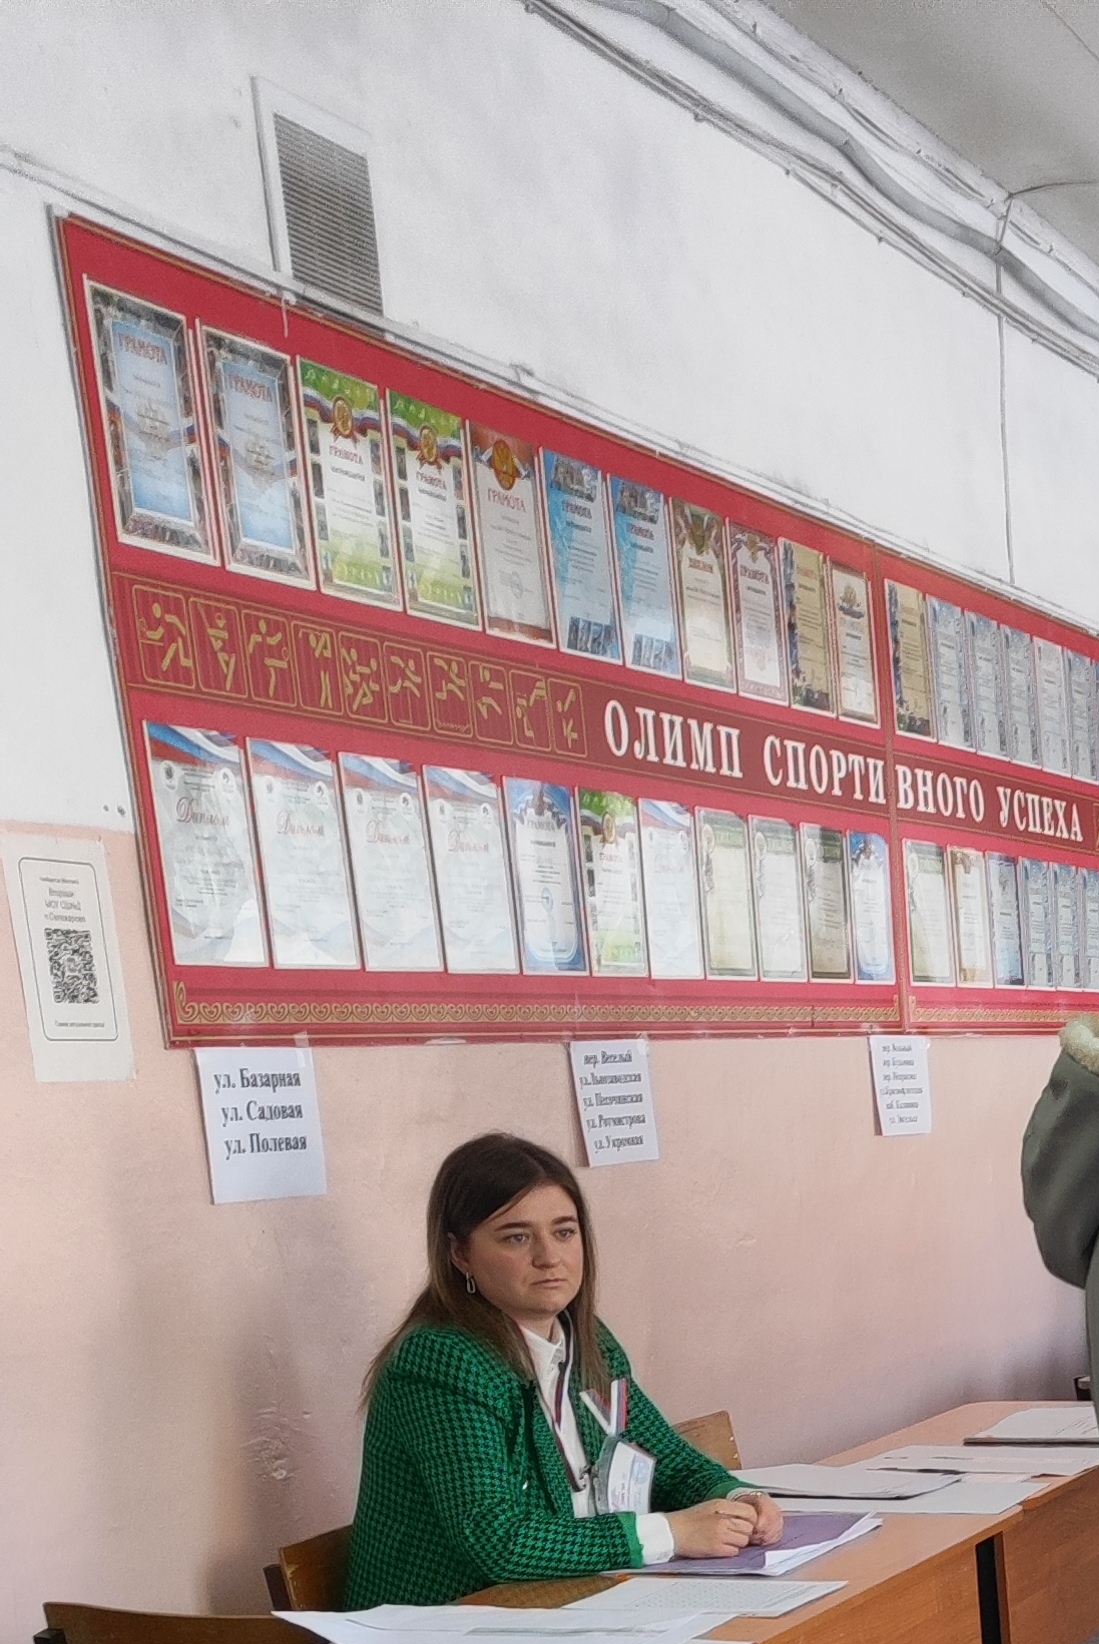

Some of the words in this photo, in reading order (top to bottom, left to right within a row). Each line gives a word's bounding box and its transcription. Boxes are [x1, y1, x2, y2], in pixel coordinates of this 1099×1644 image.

[487, 488, 527, 513] ГРАМОТА
[604, 700, 743, 778] ОЛИМП
[996, 785, 1084, 842] УСПЕХА
[176, 796, 229, 826] Диплом
[276, 809, 325, 837] Диплом
[213, 1073, 236, 1094] ул.
[239, 1067, 301, 1093] Базарная
[221, 1106, 243, 1128] ул.
[246, 1099, 303, 1122] Садовая
[224, 1139, 246, 1161] ул.
[249, 1132, 307, 1154] Полевая
